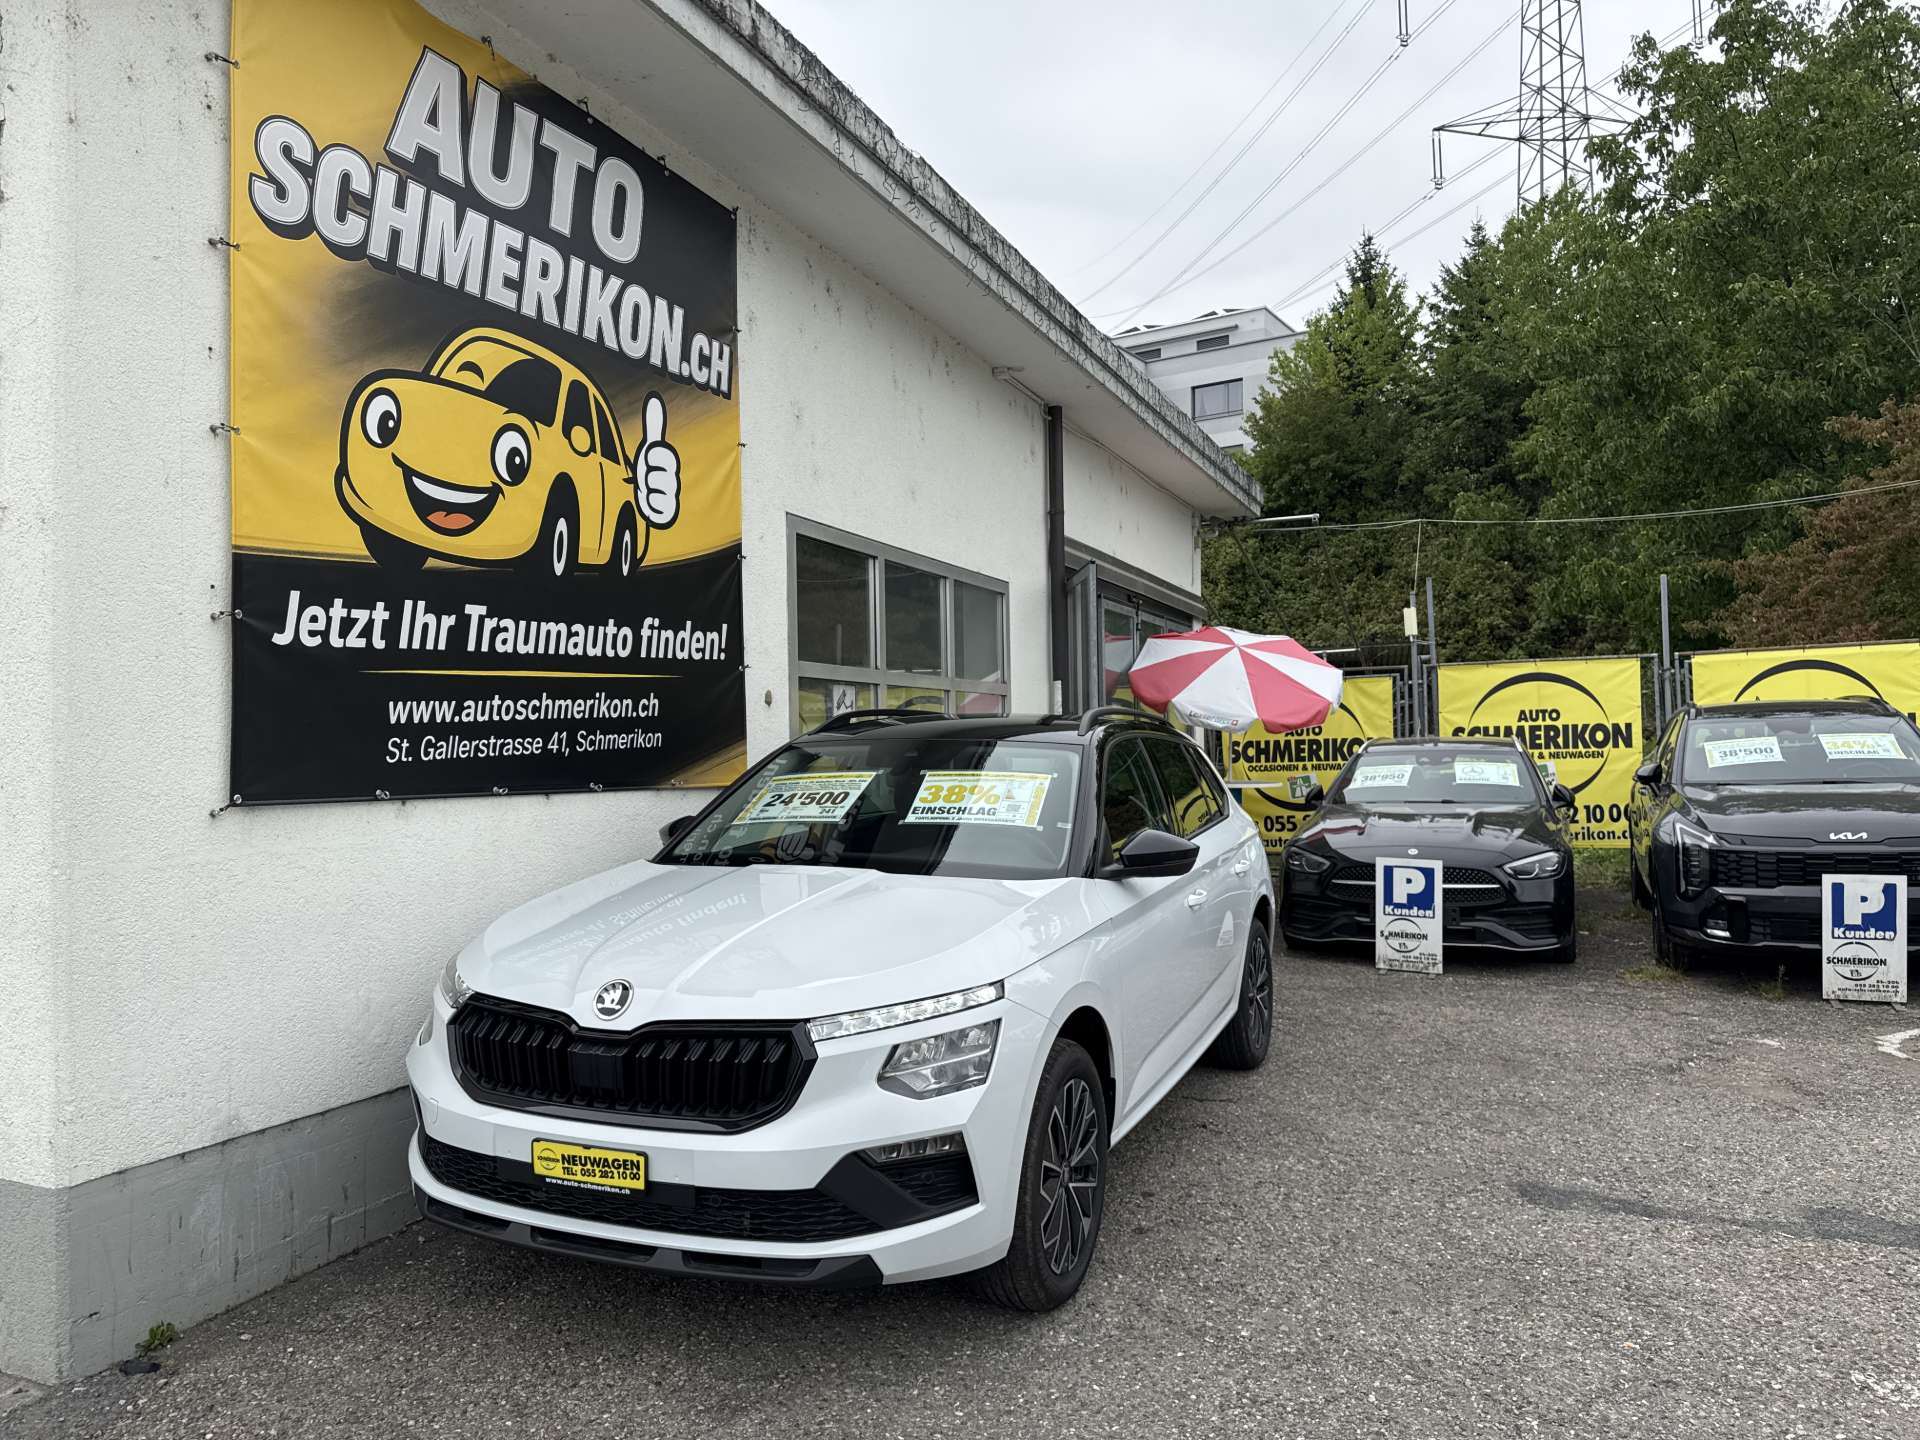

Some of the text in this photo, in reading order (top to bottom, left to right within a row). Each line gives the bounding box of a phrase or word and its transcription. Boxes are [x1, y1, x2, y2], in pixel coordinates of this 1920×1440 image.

[385, 46, 643, 263] AUTO
[249, 116, 732, 397] SCHMERIKON.CH
[272, 590, 728, 660] Jetzt Ihr Traumauto finden!
[388, 692, 659, 724] www.autoschmerikon.ch
[1517, 708, 1560, 722] AUTO
[386, 730, 662, 763] St. Gallerstrasse 41, Schmerikon
[1231, 737, 1372, 764] SCHMERIKO
[1537, 751, 1545, 760] &
[1548, 750, 1604, 759] NEUWAGEN
[1247, 762, 1346, 773] OCCASIONEN & NEUWA
[762, 791, 850, 807] 24'500
[918, 784, 1000, 804] 38%
[911, 806, 998, 816] EINSCHLAG
[1584, 804, 1604, 823] 10
[1263, 815, 1298, 832] 055
[1393, 867, 1426, 904] P
[1384, 904, 1434, 918] Kunden
[1843, 883, 1886, 925] P
[1380, 930, 1428, 941] SHMERIKON
[1833, 927, 1896, 940] Kunden
[1826, 956, 1887, 967] SCHMERIKON
[560, 1153, 641, 1172] NEUWAGEN
[562, 1166, 641, 1181] TEL: 055 282 10 00
